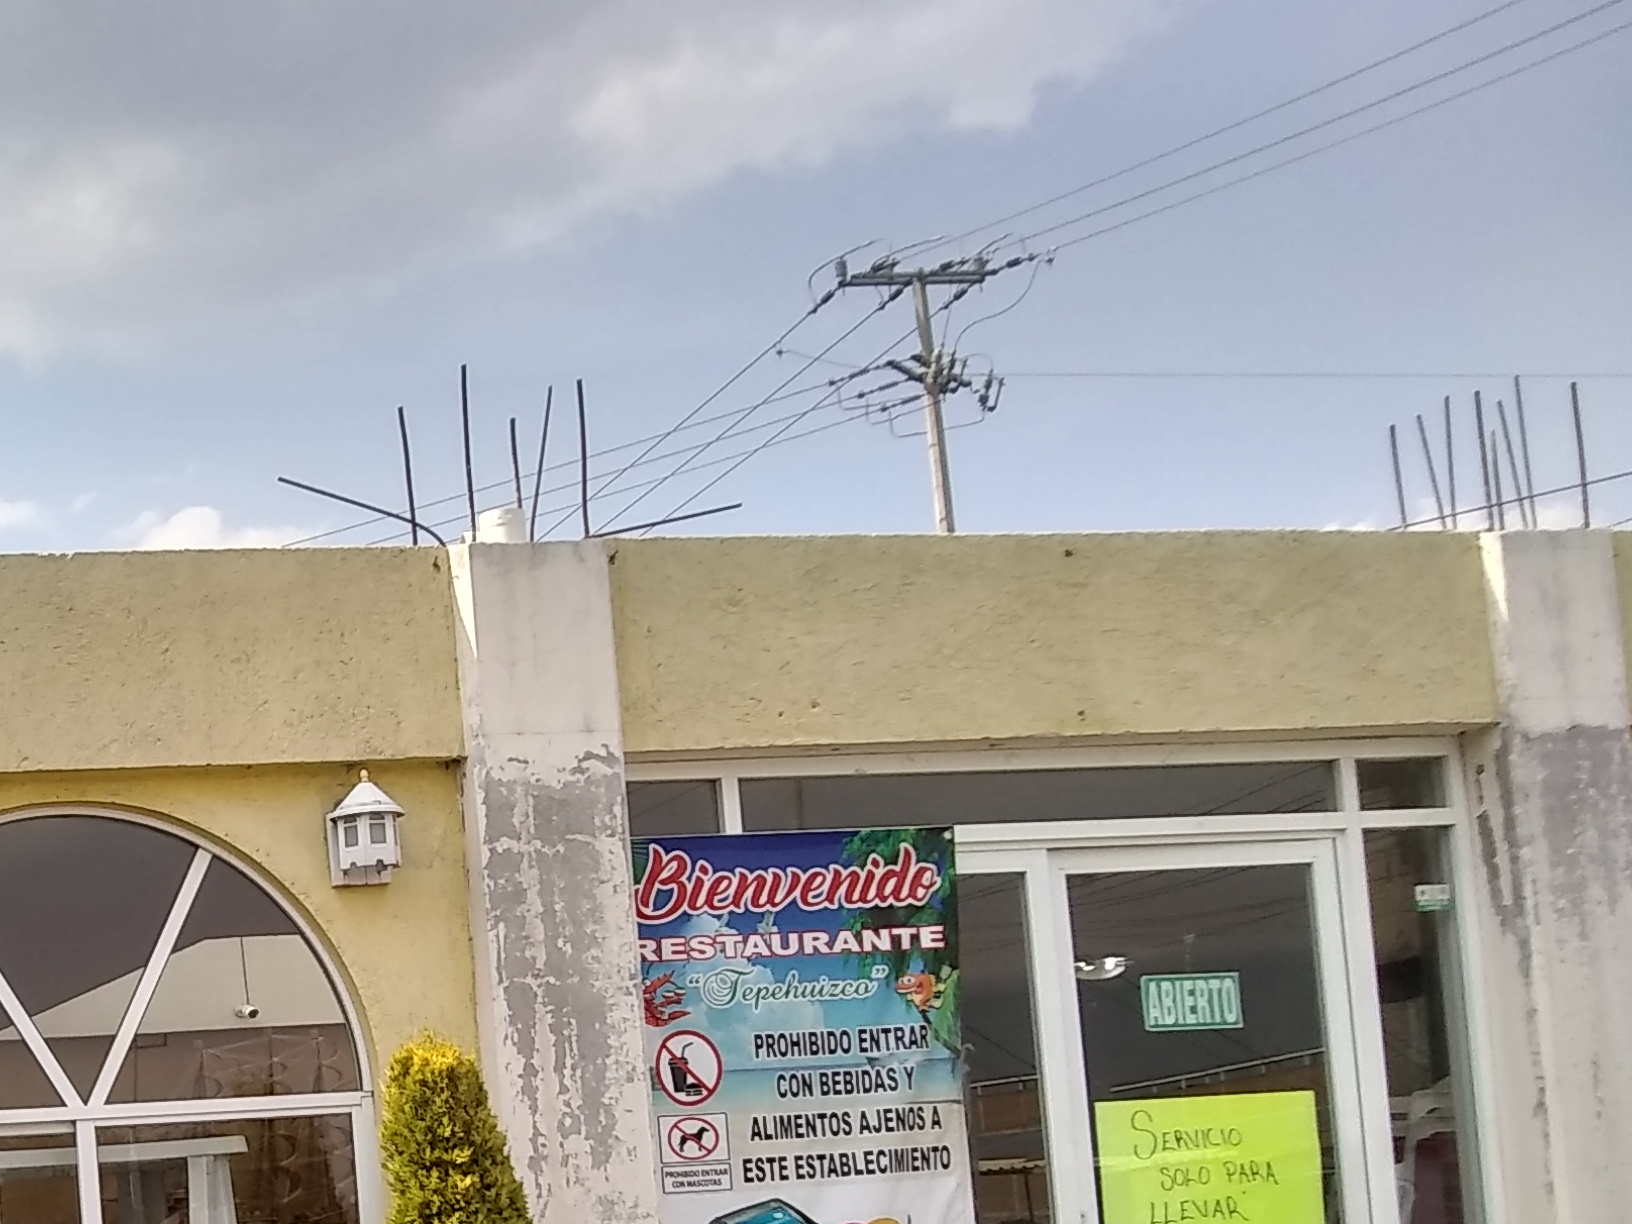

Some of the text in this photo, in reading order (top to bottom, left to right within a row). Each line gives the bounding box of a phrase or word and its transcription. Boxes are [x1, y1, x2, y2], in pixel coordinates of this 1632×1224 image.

[635, 843, 941, 924] Bienvenido
[638, 925, 946, 962] RESTAURANTE
[1149, 978, 1238, 1026] ABIERTO
[753, 1024, 930, 1060] PROHIBIDO ENTRAR
[776, 1066, 915, 1099] CON BEBIDAS Y
[750, 1105, 942, 1142] ALIMENTOS AJENOS A
[701, 1168, 728, 1177] ENTRAR
[742, 1144, 951, 1184] ESTE ESTABLECIMIENTO
[1160, 1161, 1278, 1191] SOLO PARA
[672, 1178, 722, 1188] CON MASCOTAS
